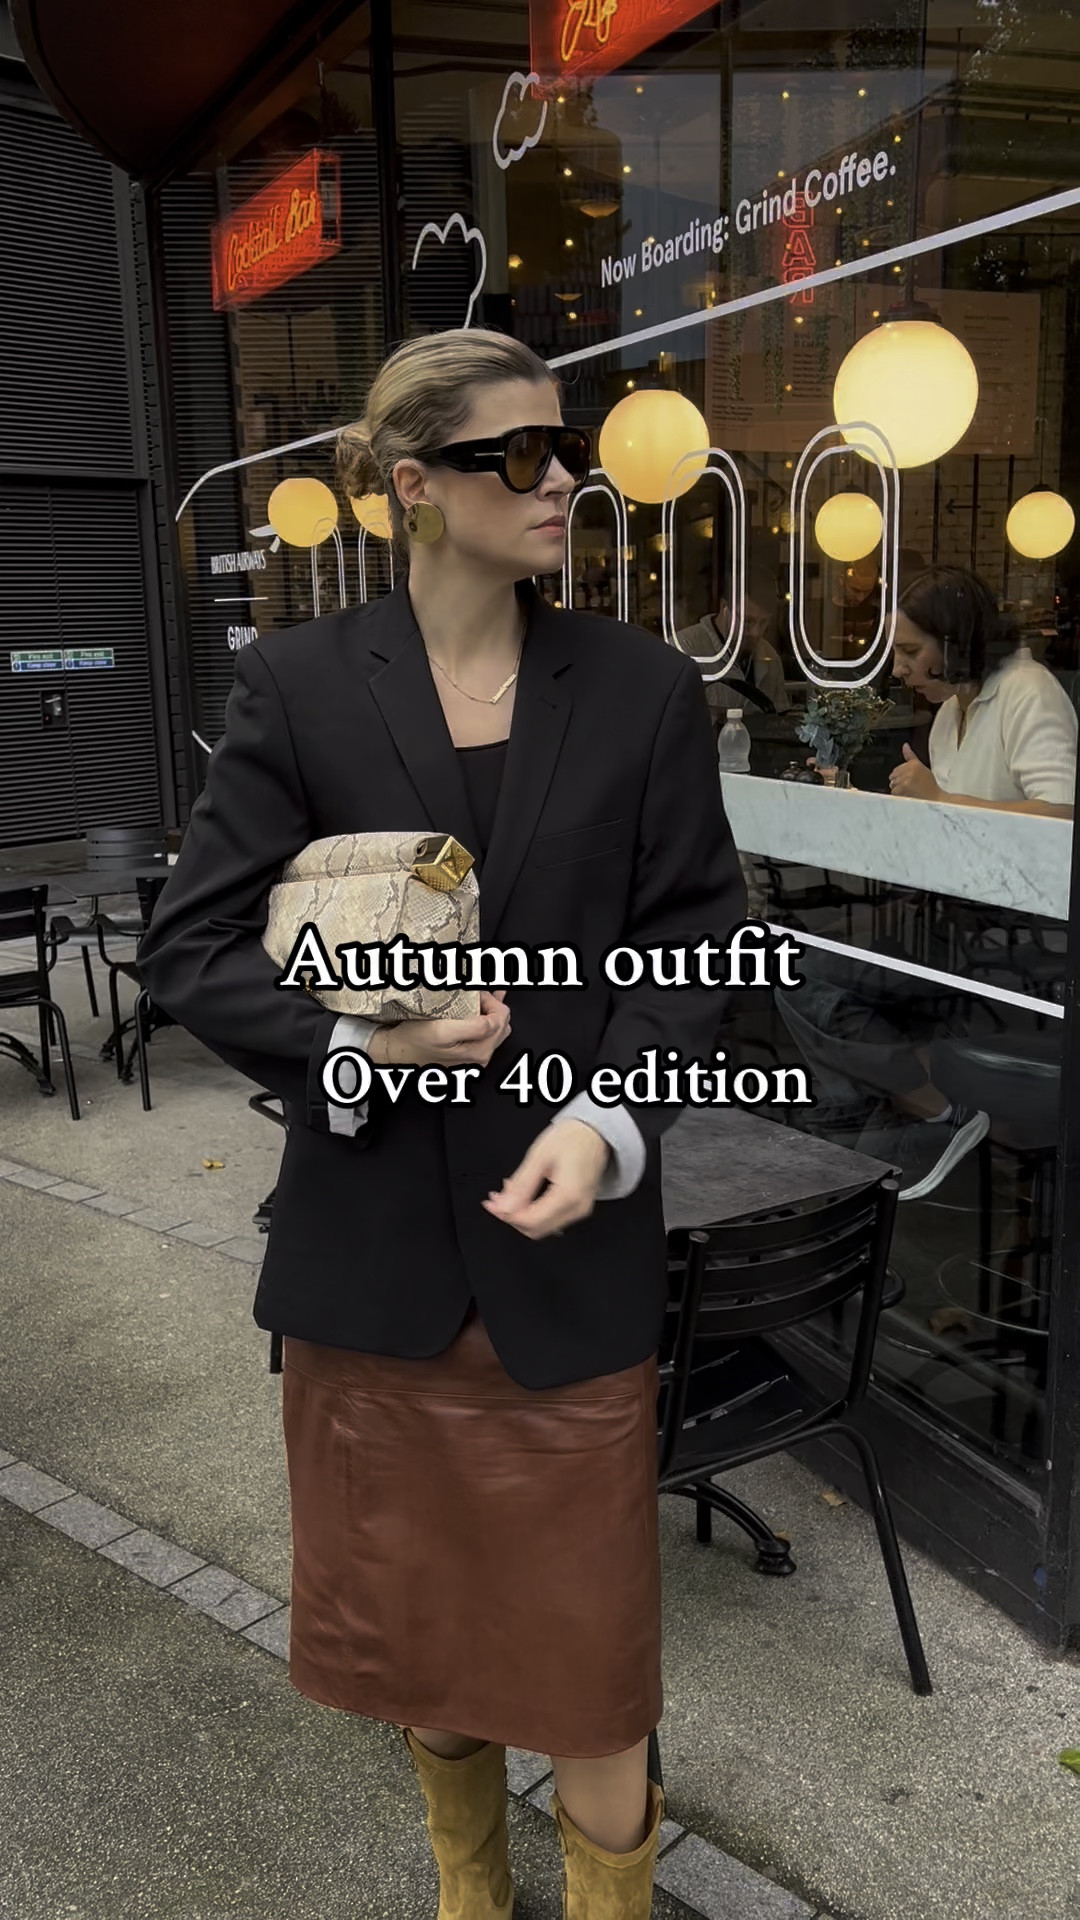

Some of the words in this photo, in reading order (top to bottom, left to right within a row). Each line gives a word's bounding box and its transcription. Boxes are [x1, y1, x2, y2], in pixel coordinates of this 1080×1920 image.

[285, 188, 317, 242] Bar
[601, 251, 638, 289] Now
[641, 216, 730, 273] Boarding:
[735, 178, 797, 235] Grind
[804, 151, 897, 208] Coffee.
[210, 553, 236, 575] BRITISH
[237, 549, 267, 571] AIRWAYS
